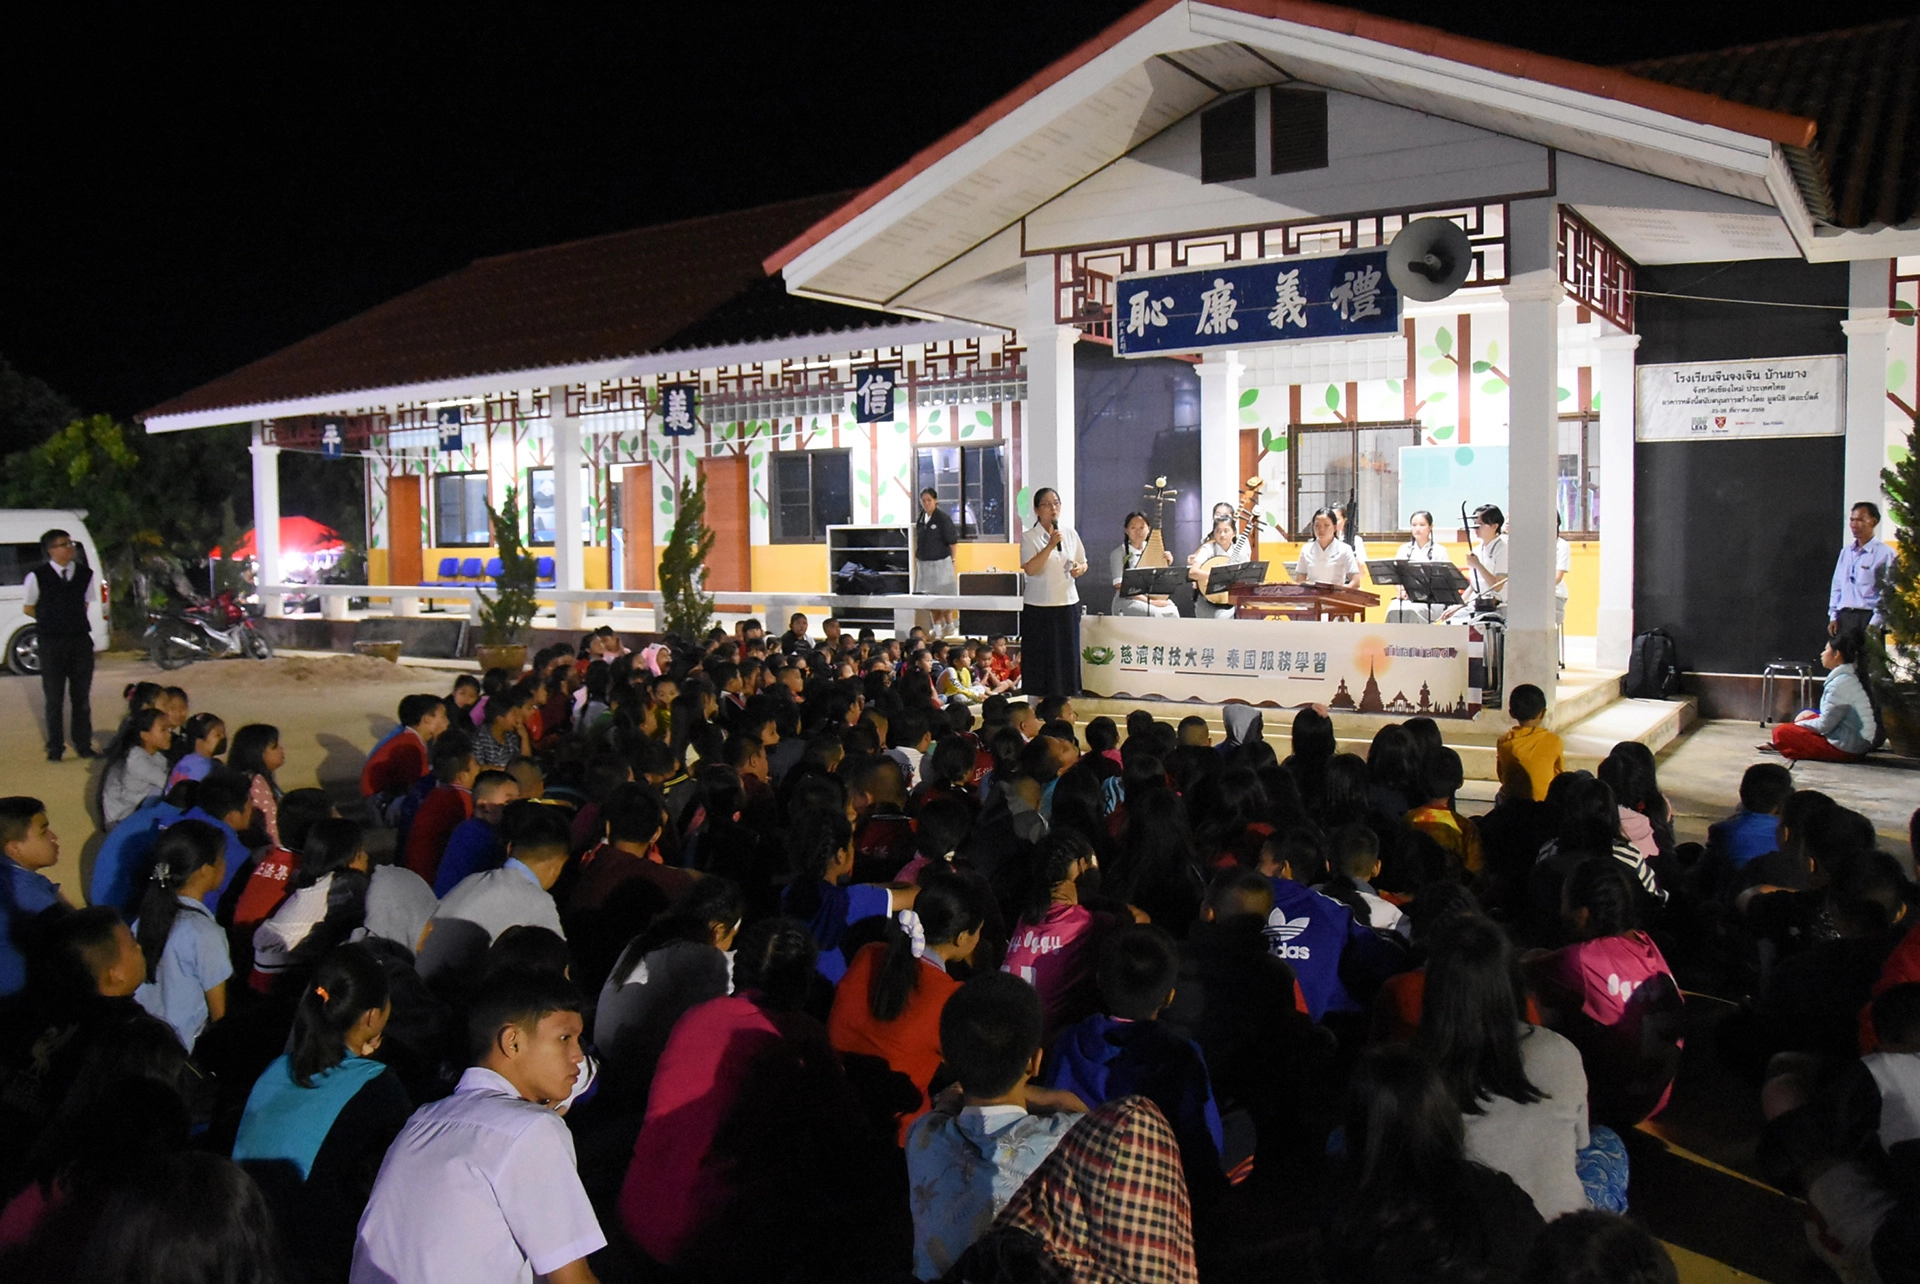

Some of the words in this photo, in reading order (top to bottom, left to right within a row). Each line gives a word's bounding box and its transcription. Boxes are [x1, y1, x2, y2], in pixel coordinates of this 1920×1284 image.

[1674, 370, 1761, 383] โรงเรียนจีนจงเจิน
[1765, 368, 1807, 380] บ้านยาง
[1746, 382, 1786, 392] ประเทศไทย
[858, 374, 895, 416] 信
[664, 389, 693, 431] 義
[438, 413, 461, 445] 和
[1119, 645, 1215, 669] 慈濟科技大學
[1387, 645, 1451, 659] Thailand
